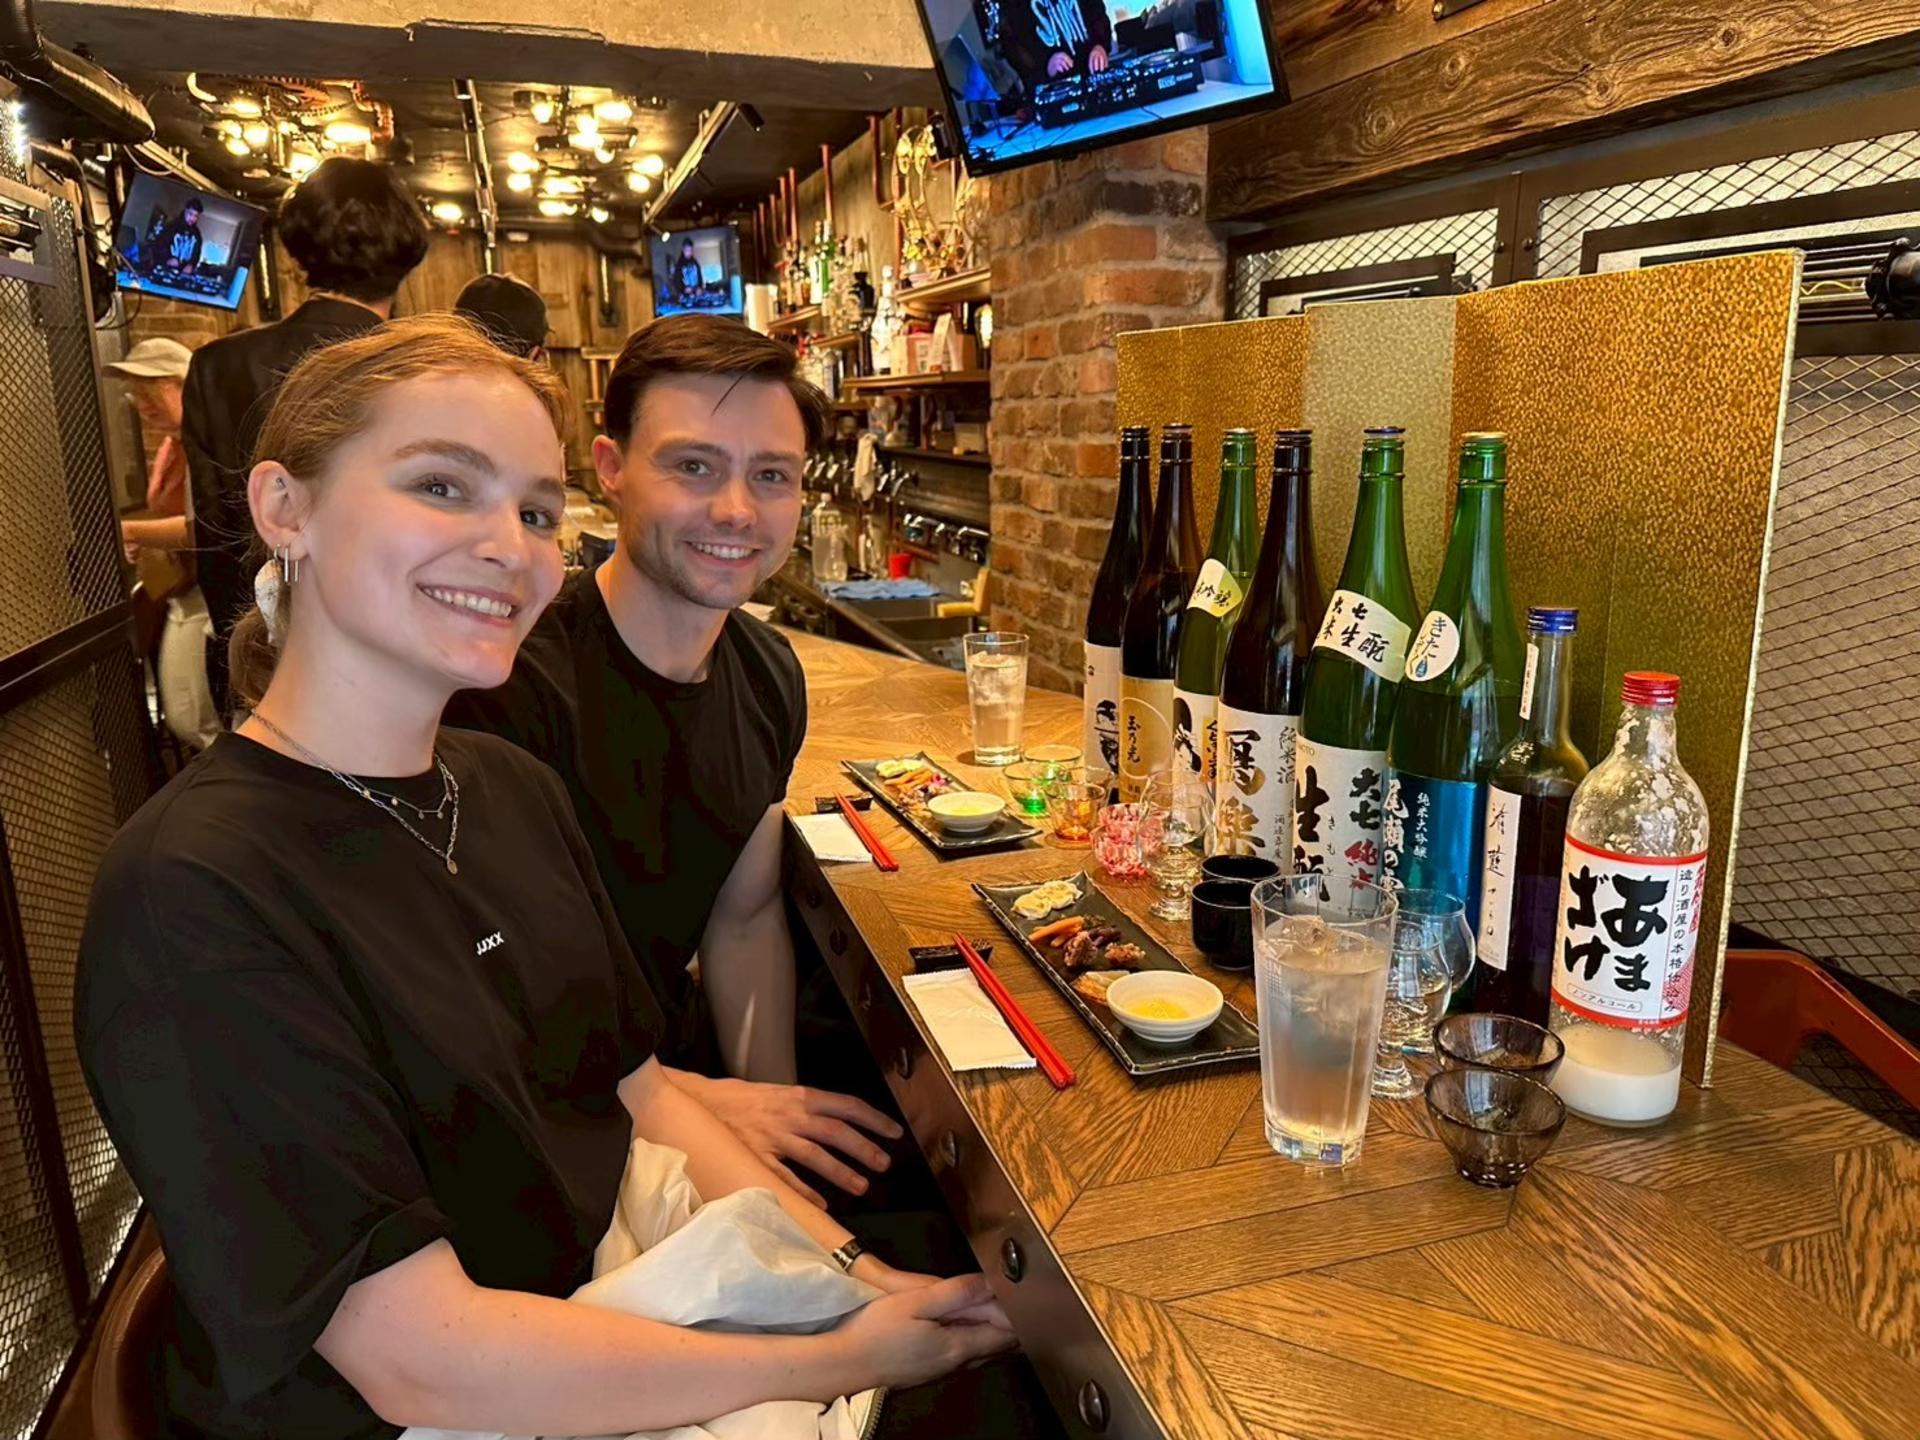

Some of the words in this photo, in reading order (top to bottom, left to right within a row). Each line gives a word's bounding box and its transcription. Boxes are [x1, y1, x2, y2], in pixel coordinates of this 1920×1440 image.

[1420, 616, 1448, 659] きた
[1349, 766, 1382, 831] 大七
[1413, 791, 1431, 860] 純米大吟醸
